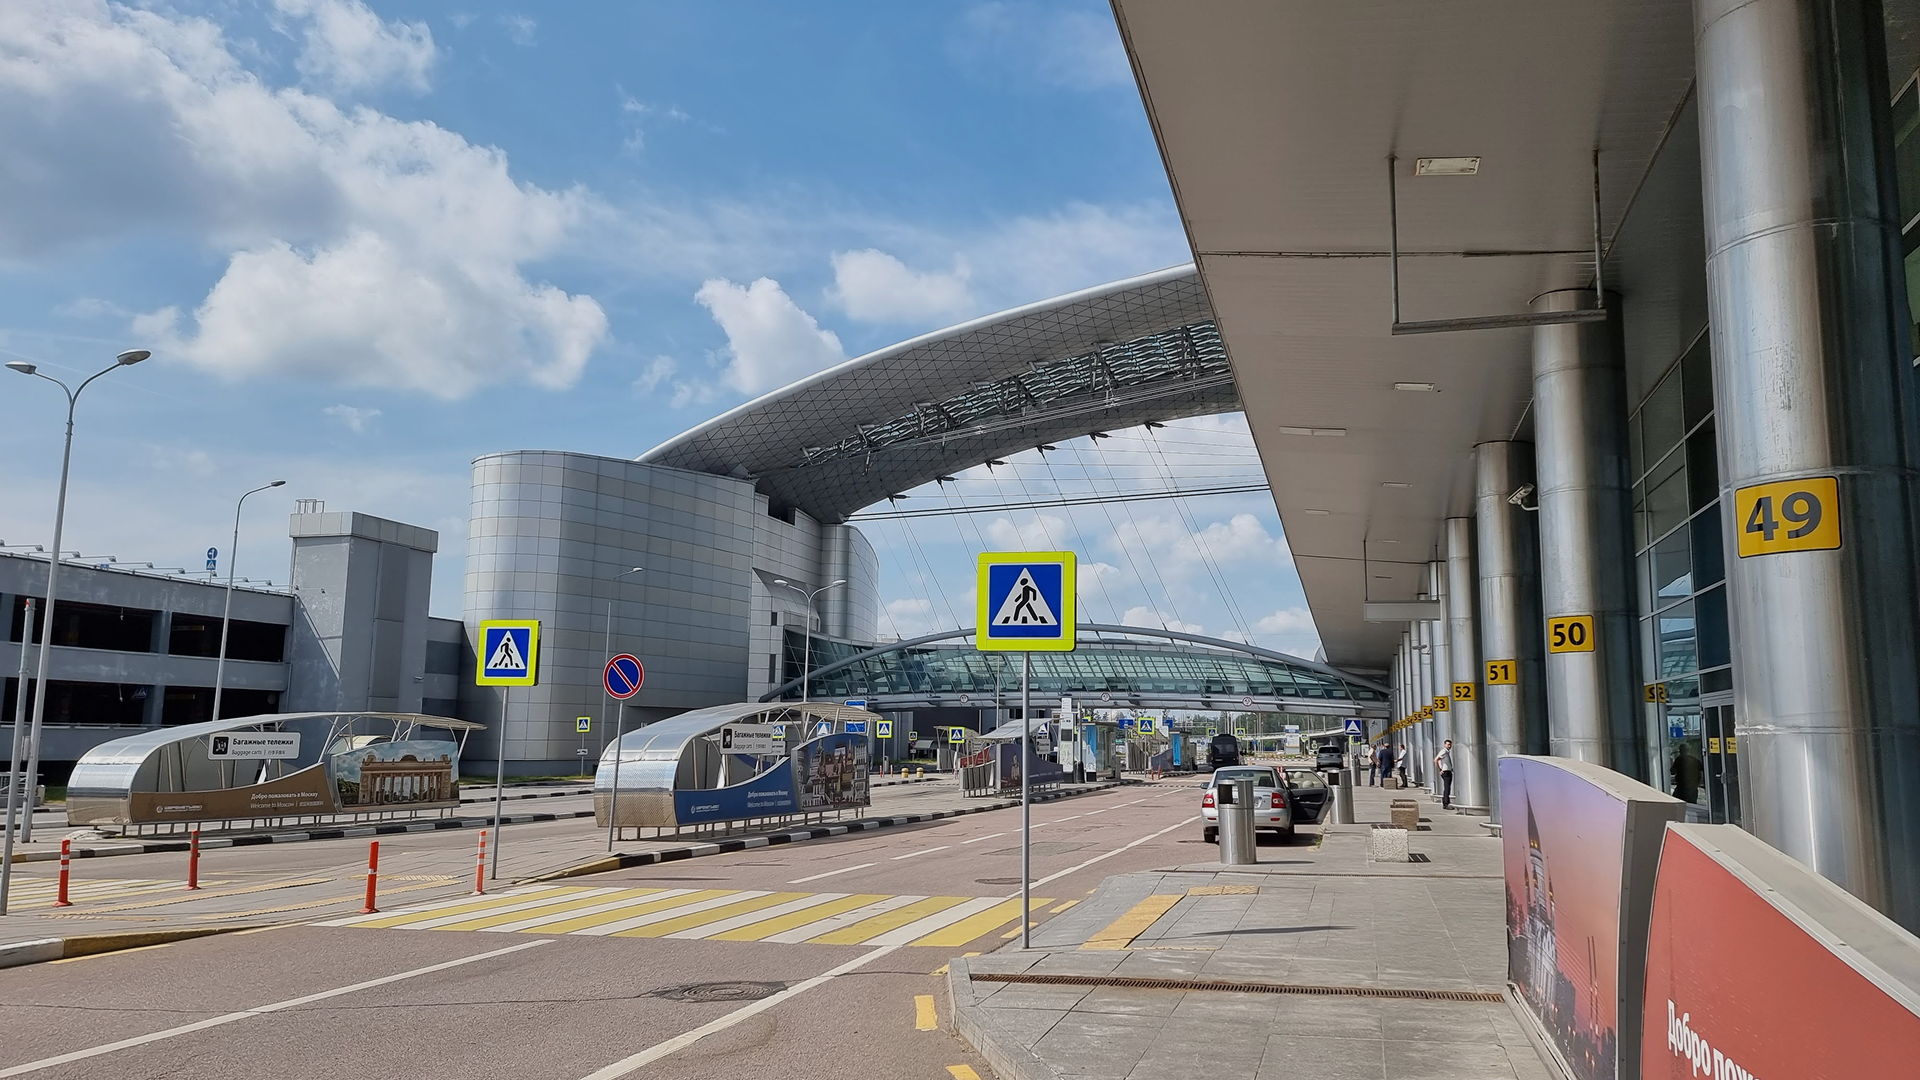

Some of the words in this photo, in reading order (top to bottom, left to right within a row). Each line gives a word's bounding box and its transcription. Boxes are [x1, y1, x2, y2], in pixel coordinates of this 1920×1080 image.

[1746, 491, 1822, 541] 49
[1553, 622, 1587, 647] 50
[1489, 664, 1509, 681] 51
[1455, 686, 1472, 698] 52
[1434, 699, 1446, 709] 53
[1423, 708, 1433, 717] 54
[734, 731, 754, 739] Багажные
[232, 738, 266, 746] Багажные
[232, 749, 251, 757] Baggage
[250, 793, 268, 801] Добро
[301, 791, 319, 799] Москву
[1667, 998, 1712, 1079] Добро
